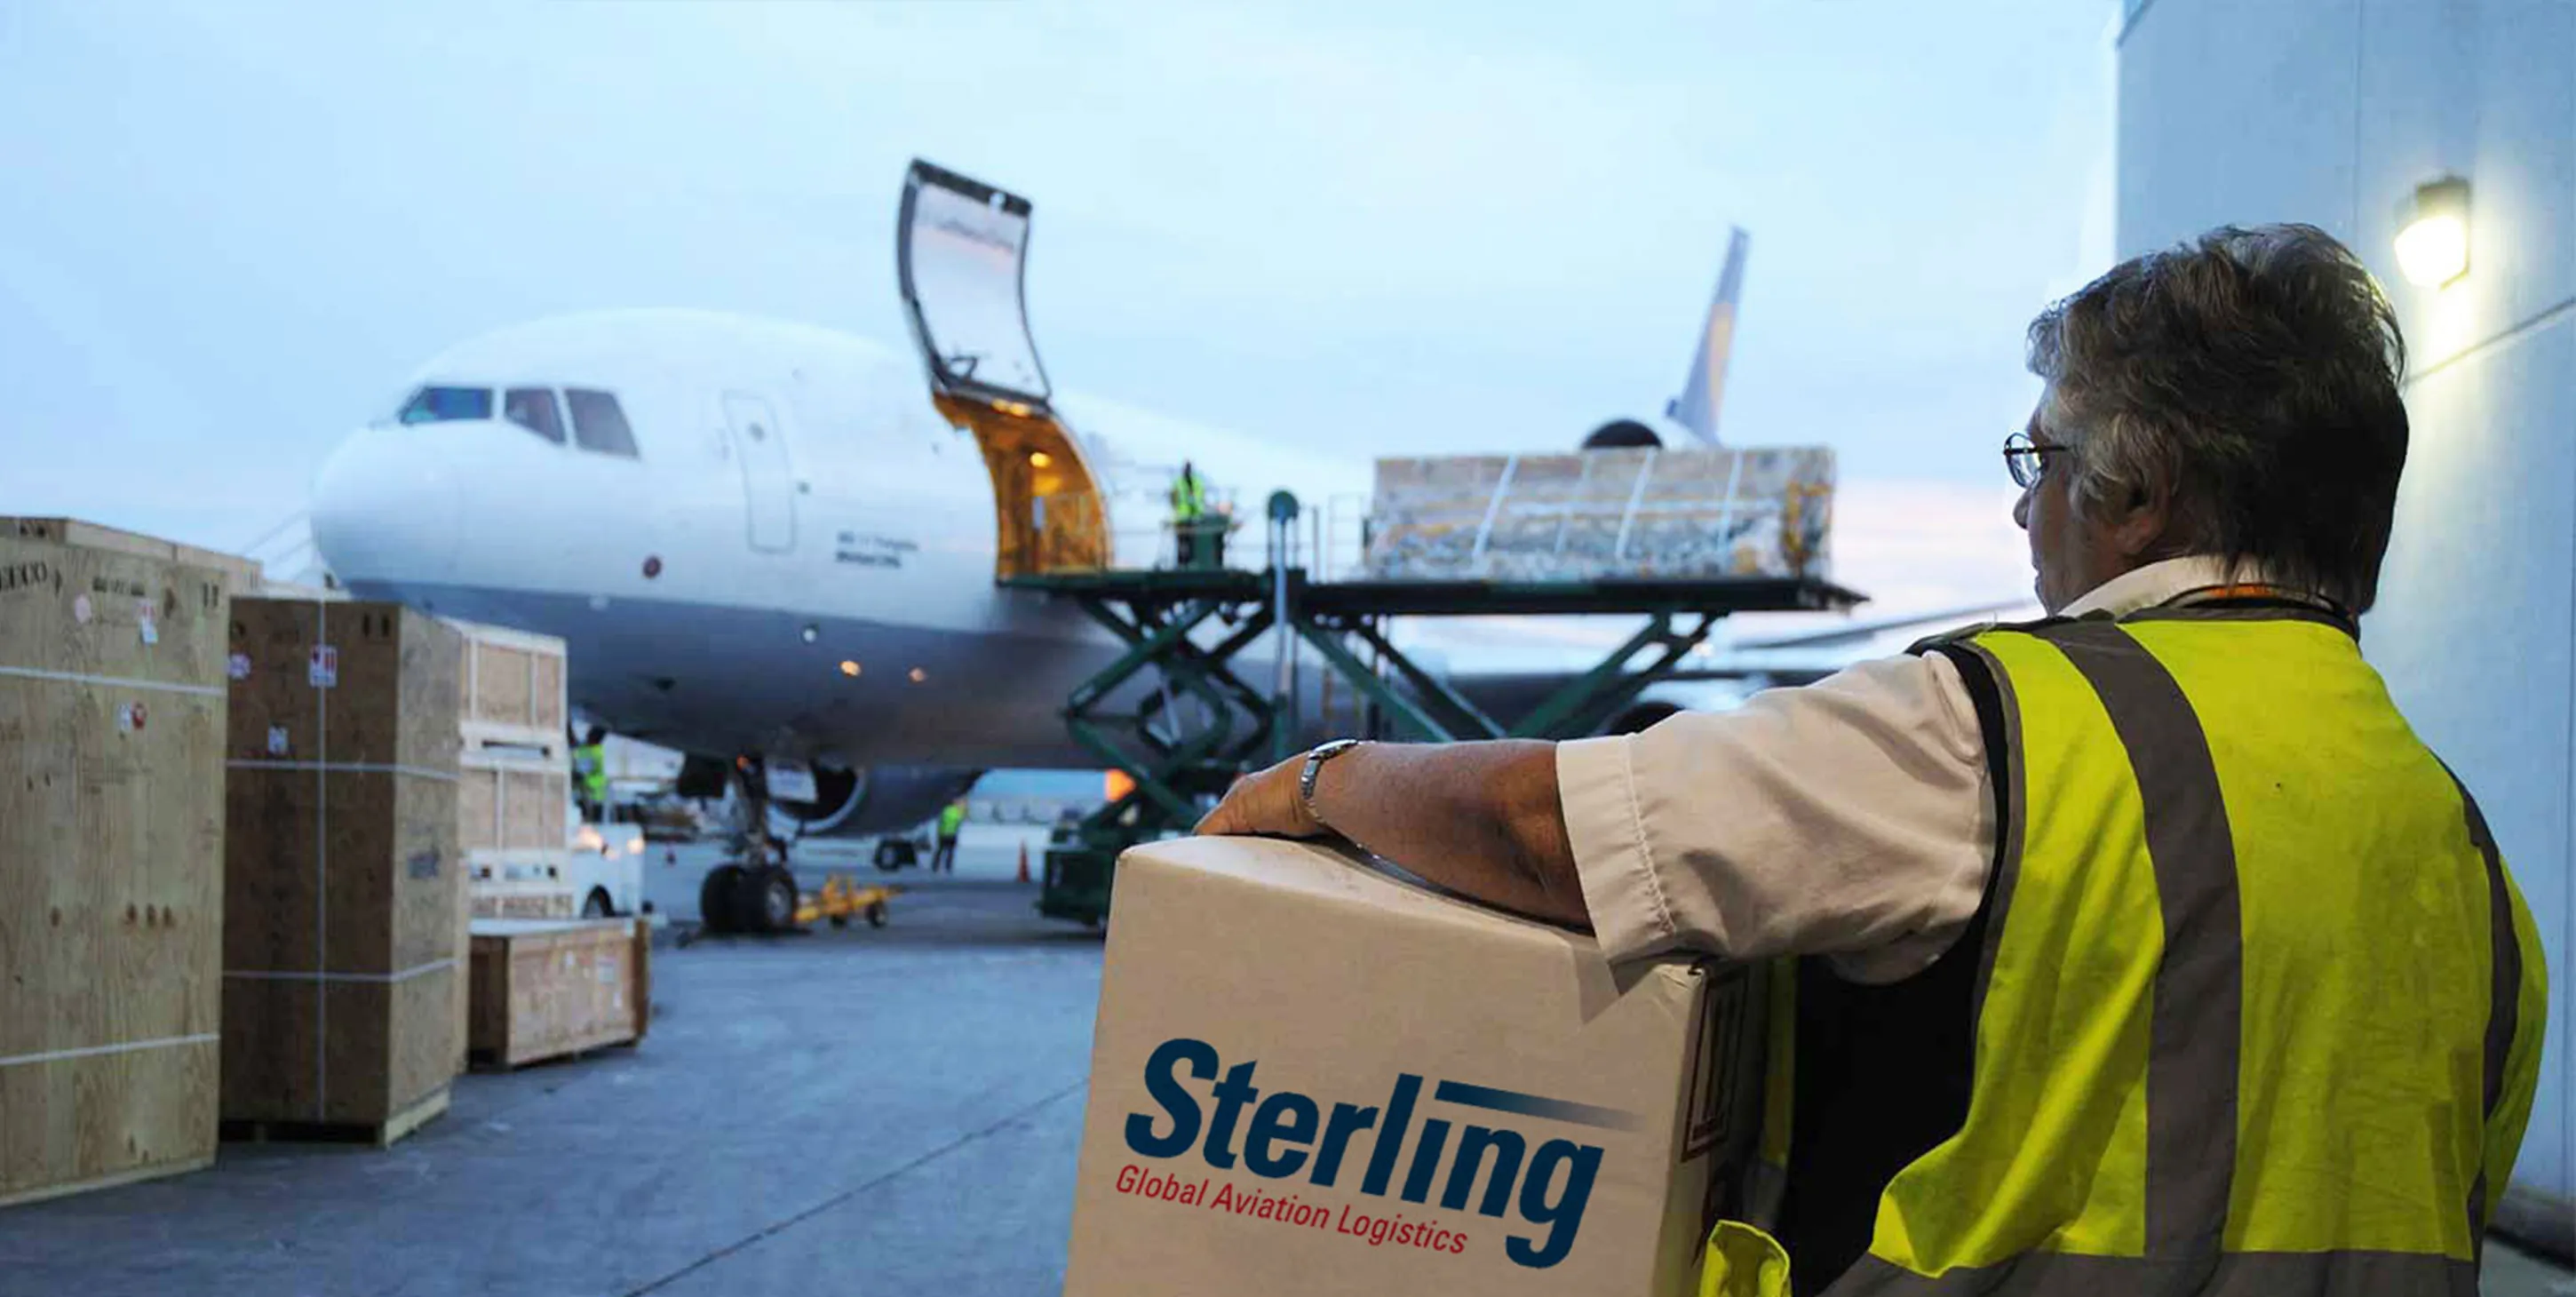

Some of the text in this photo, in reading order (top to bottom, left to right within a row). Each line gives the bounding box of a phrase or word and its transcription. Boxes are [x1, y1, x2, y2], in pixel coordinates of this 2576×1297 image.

[1116, 1164, 1467, 1254] Global Aviation Logistics
[1125, 1038, 1604, 1269] Sterling
